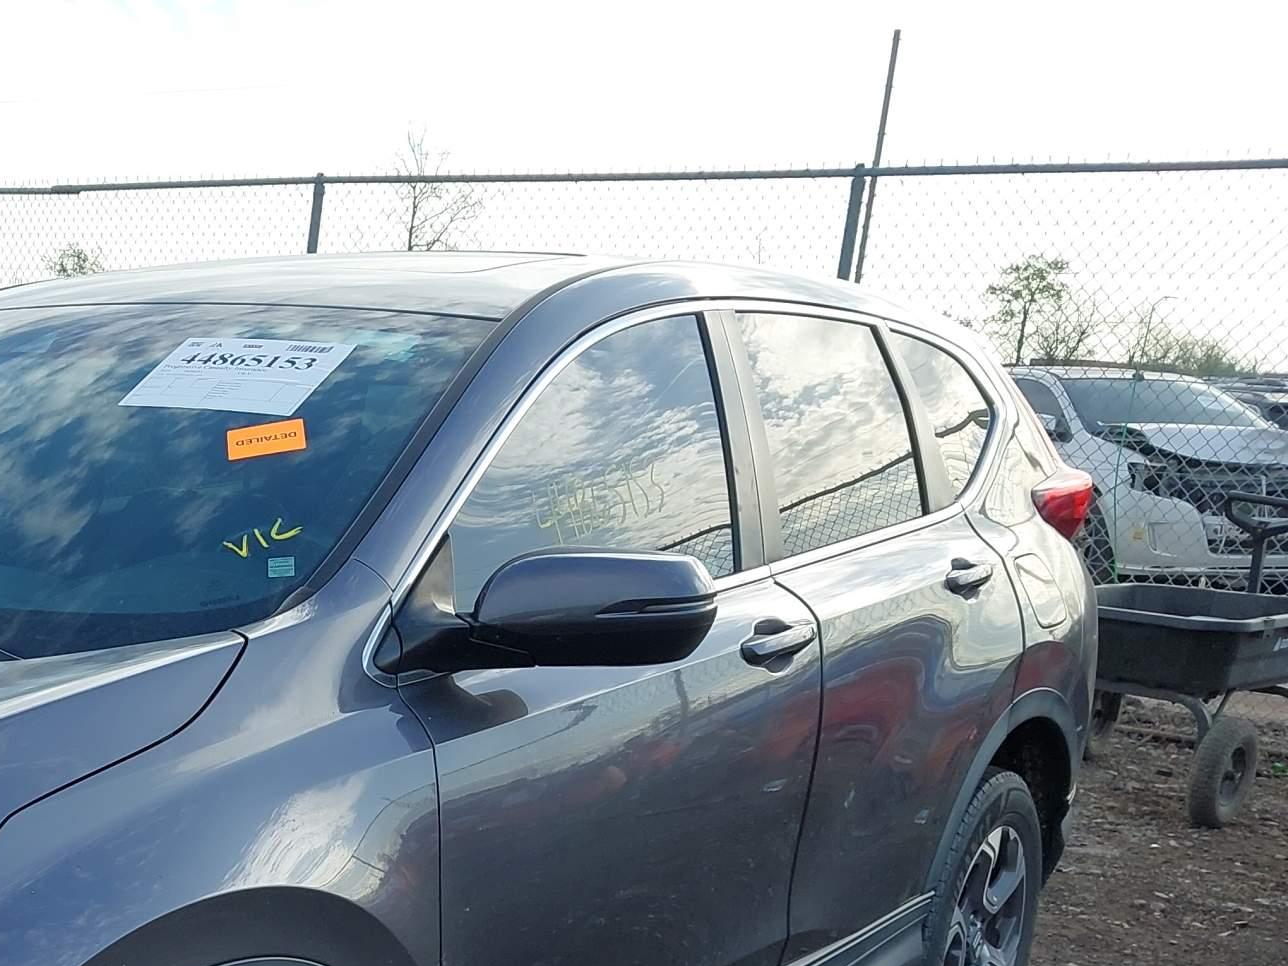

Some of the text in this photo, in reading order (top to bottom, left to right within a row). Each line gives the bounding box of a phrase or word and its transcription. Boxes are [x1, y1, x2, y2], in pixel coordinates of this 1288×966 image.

[180, 351, 318, 370] 44865153
[234, 430, 298, 447] DETAILED
[222, 517, 304, 558] VIC
